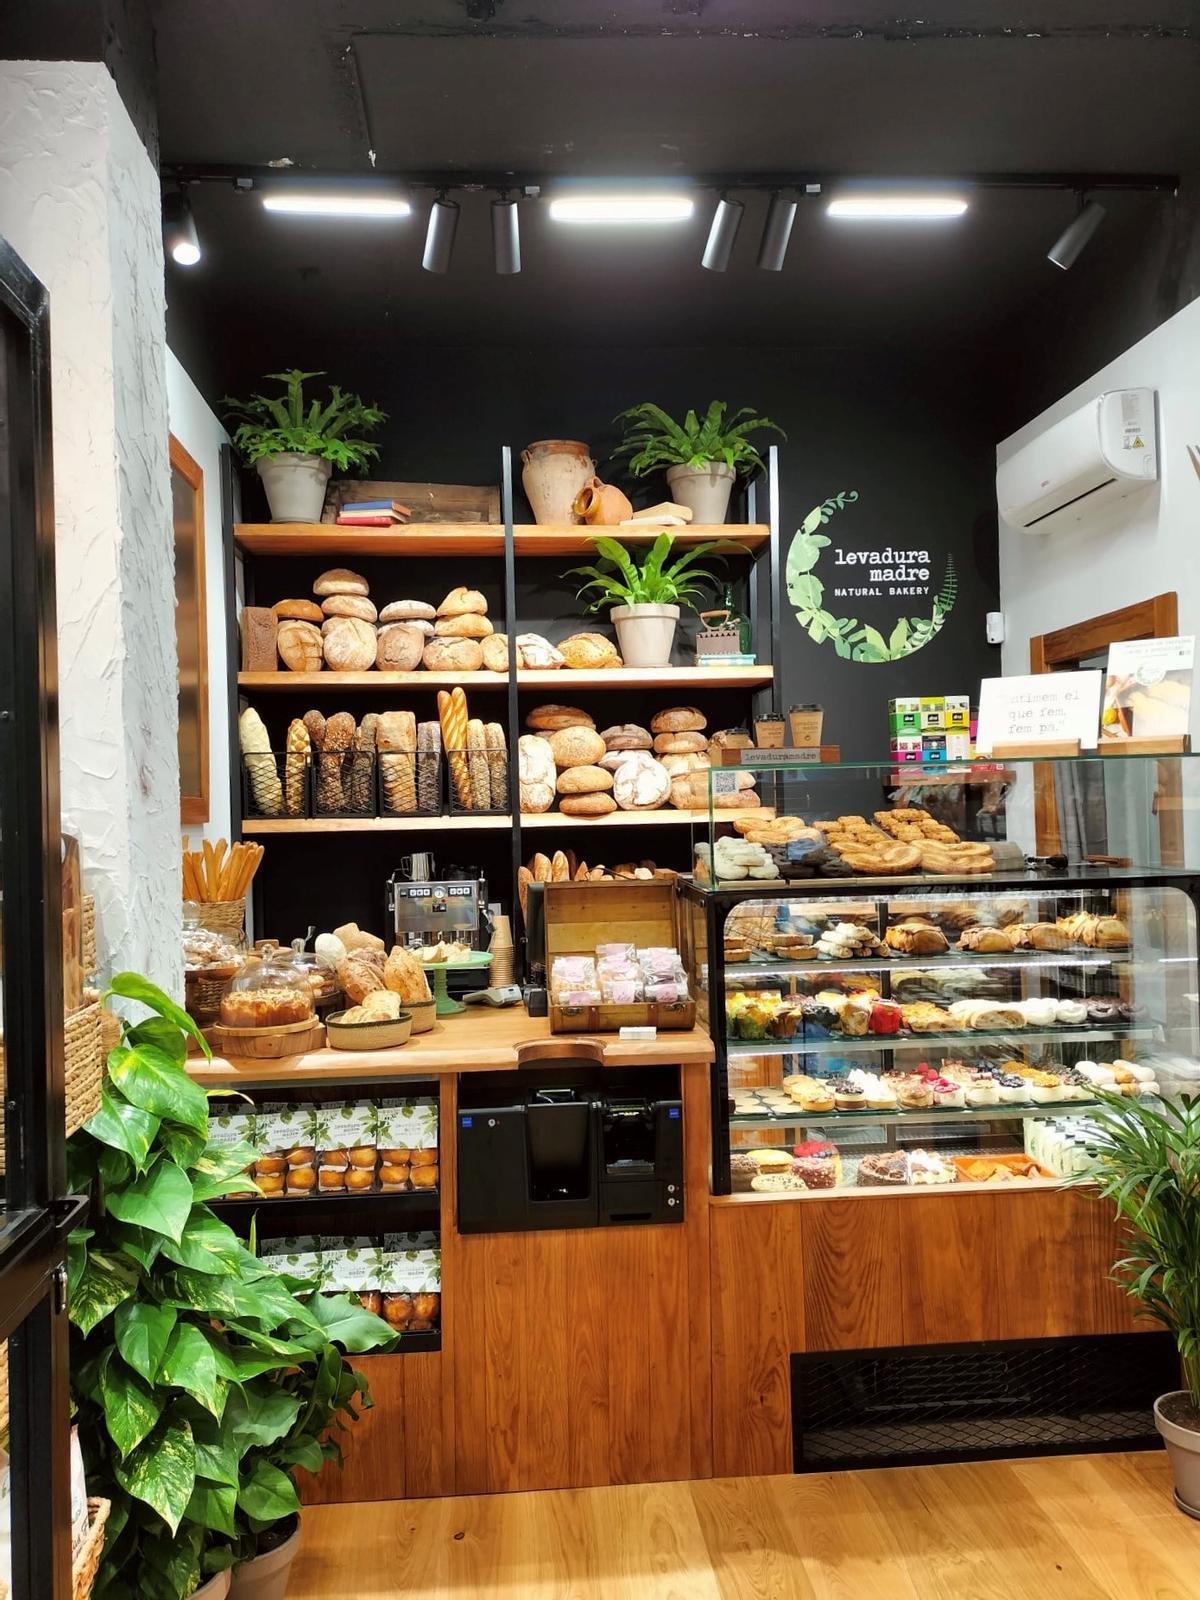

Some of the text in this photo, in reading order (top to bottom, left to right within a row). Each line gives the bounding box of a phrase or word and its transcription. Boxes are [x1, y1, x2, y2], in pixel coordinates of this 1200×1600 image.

[834, 547, 931, 565] levadura
[869, 564, 930, 582] madre
[834, 586, 930, 596] NATURAL BAKERY
[1008, 710, 1033, 721] que
